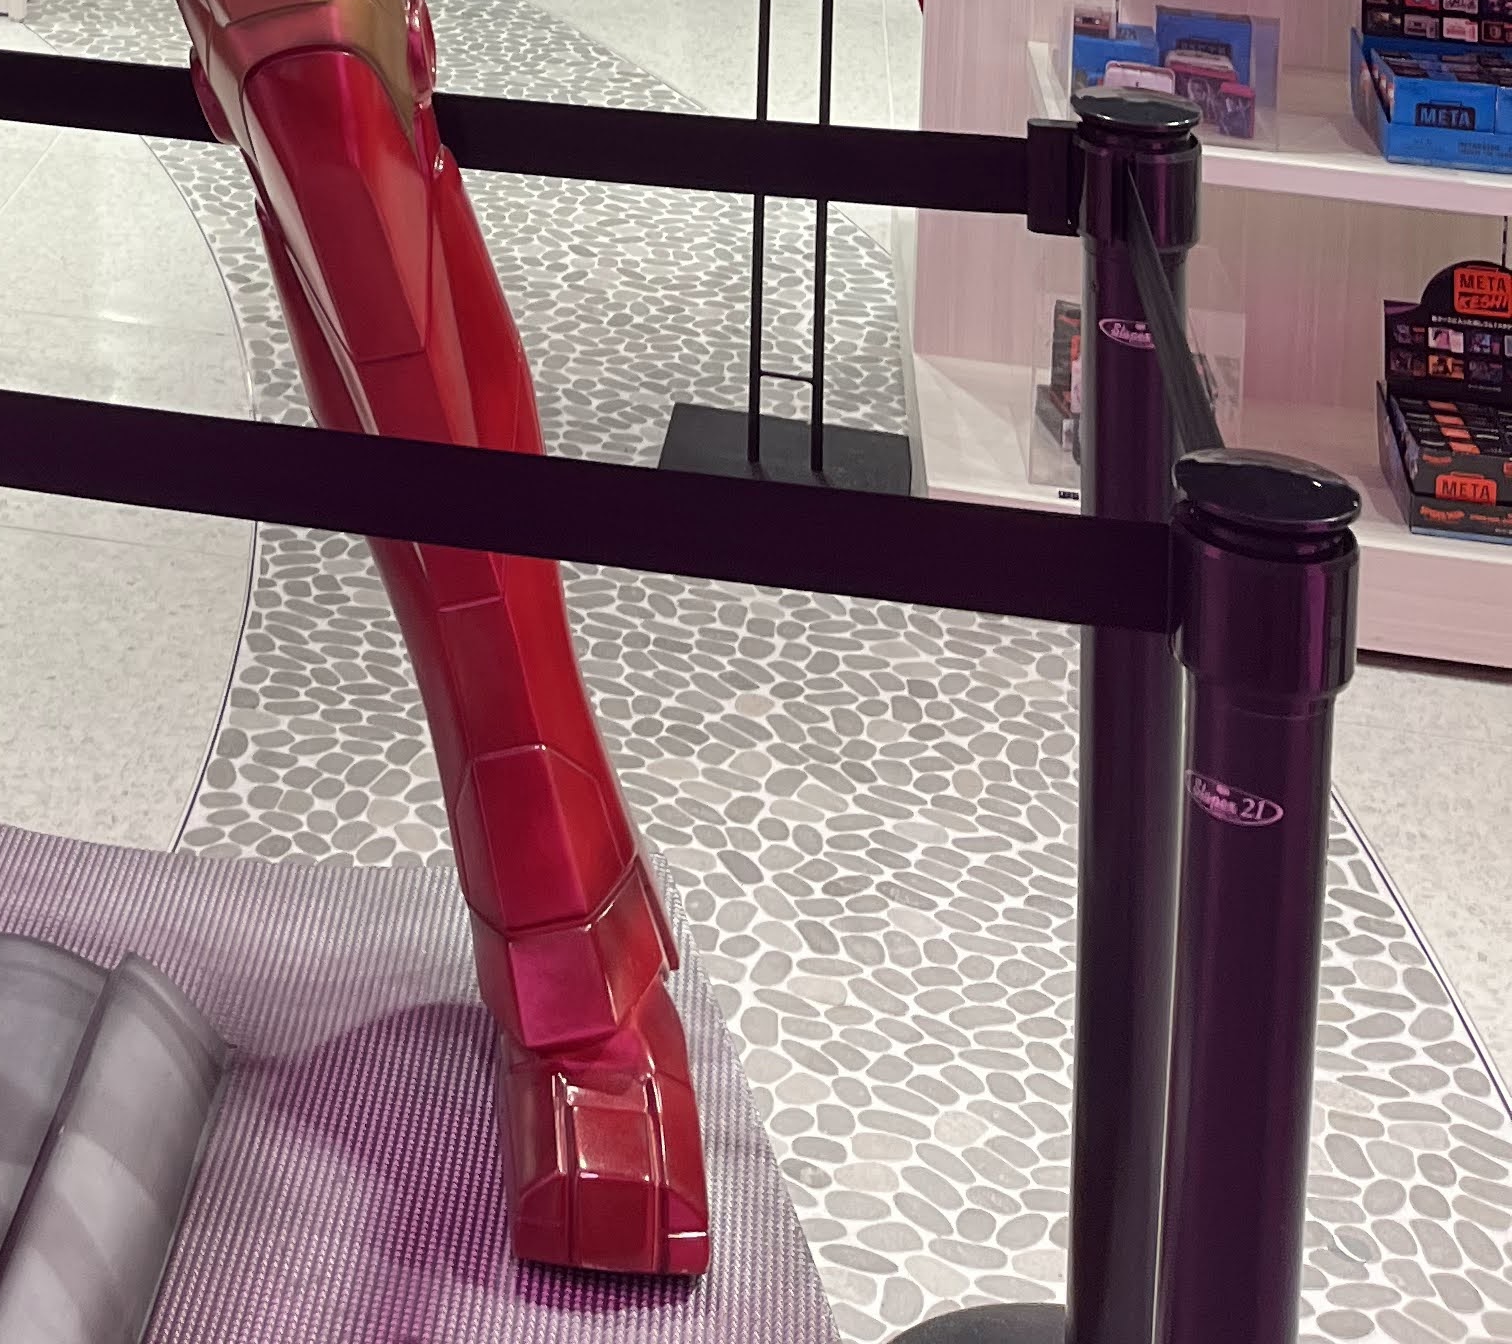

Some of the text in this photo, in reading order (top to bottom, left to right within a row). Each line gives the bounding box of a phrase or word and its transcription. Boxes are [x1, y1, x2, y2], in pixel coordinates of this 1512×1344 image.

[1420, 107, 1470, 127] META
[1460, 273, 1506, 293] META
[1441, 479, 1490, 501] META
[1240, 797, 1266, 820] 21
